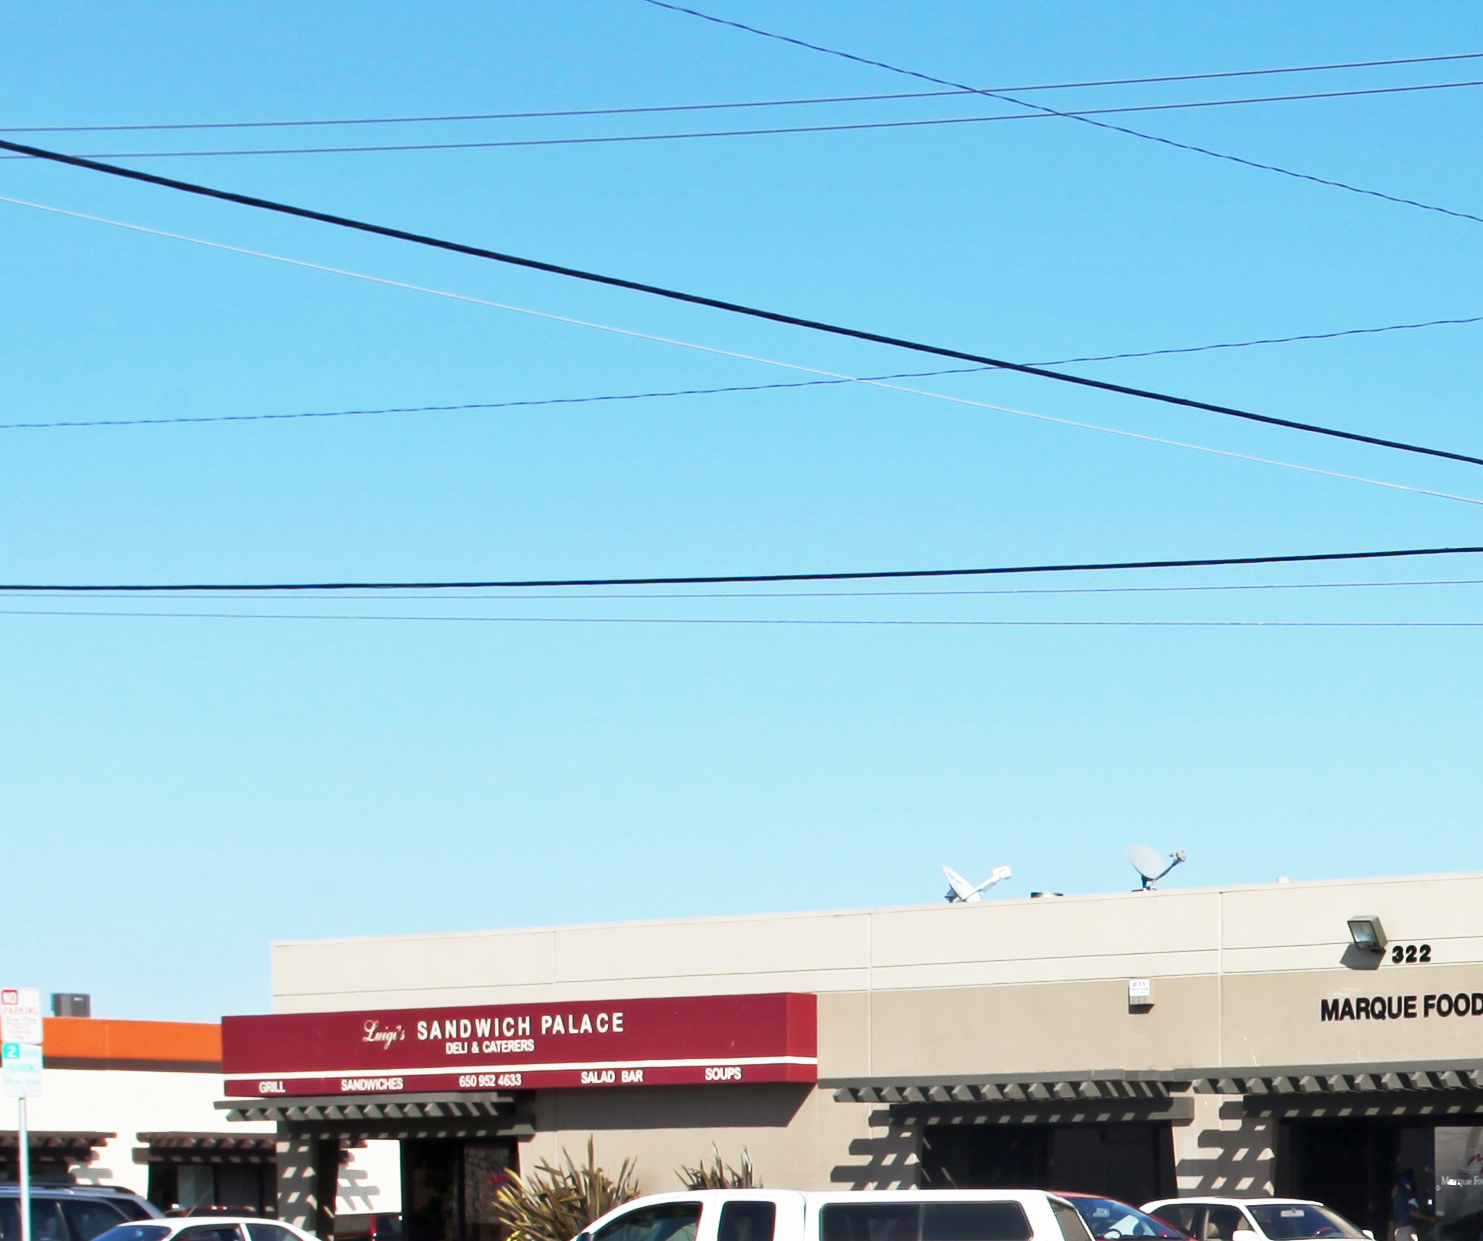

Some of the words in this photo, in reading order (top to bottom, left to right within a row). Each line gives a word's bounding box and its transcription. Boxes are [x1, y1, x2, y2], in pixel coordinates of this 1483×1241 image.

[1392, 944, 1431, 964] 322
[1321, 995, 1418, 1021] MARQUE
[362, 1019, 407, 1050] Luigi's
[416, 1017, 533, 1041] SANDWICH
[540, 1012, 626, 1036] PALACE
[7, 1046, 17, 1058] 2
[444, 1041, 469, 1055] DELI
[471, 1041, 480, 1054] &
[482, 1037, 535, 1054] CATERERS
[459, 1074, 478, 1088] 650
[479, 1074, 497, 1087] 952
[498, 1072, 522, 1087] 4633
[580, 1070, 616, 1085] SALAD
[621, 1069, 644, 1084] BAR
[704, 1066, 742, 1081] SOUPS
[259, 1081, 286, 1094] GRILL
[341, 1077, 404, 1093] SANDWICHES
